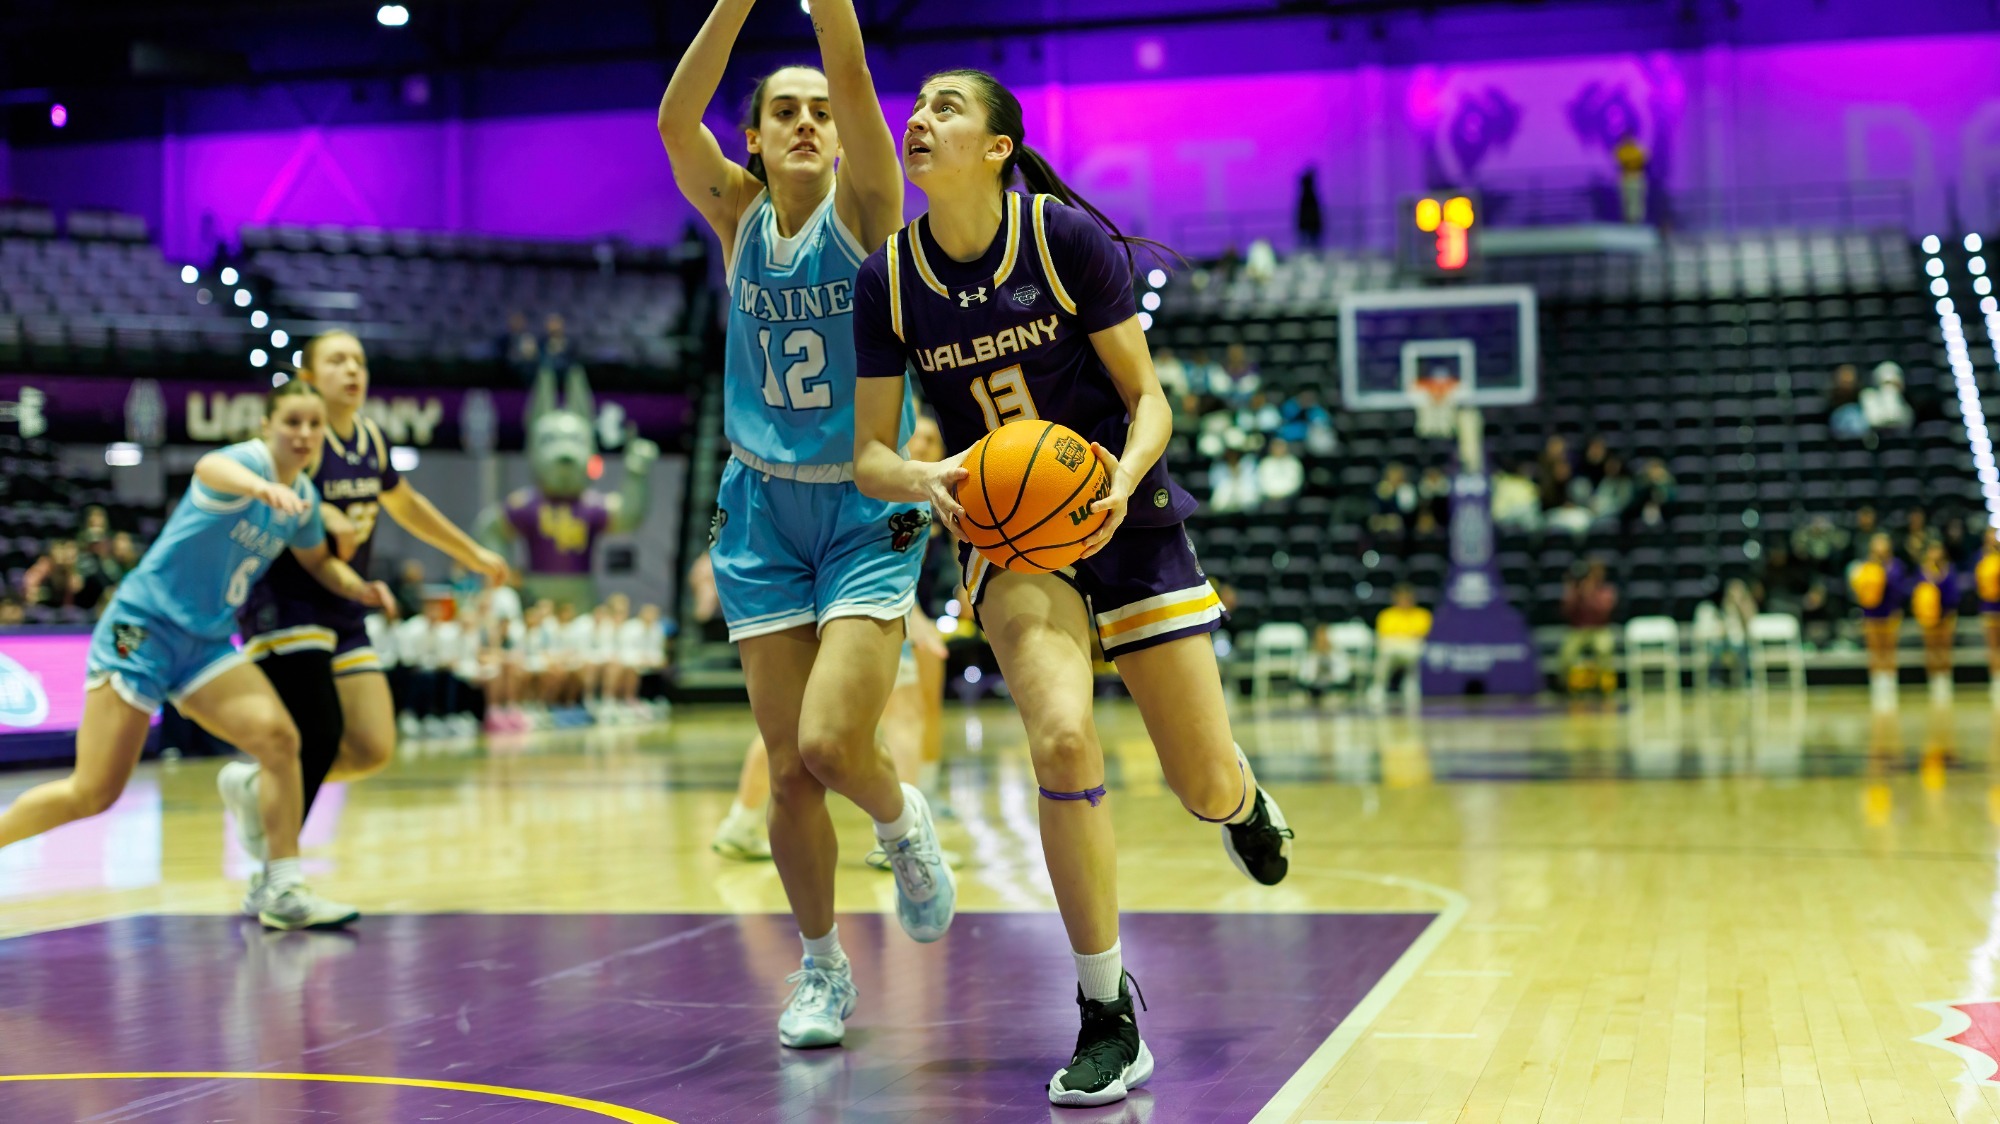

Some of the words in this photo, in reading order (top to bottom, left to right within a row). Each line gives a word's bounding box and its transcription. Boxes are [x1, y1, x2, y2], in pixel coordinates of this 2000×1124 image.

[738, 277, 854, 322] MAINE
[757, 327, 833, 411] 12
[916, 314, 1059, 372] UALBANY
[970, 363, 1040, 432] 13
[226, 556, 260, 606] 6
